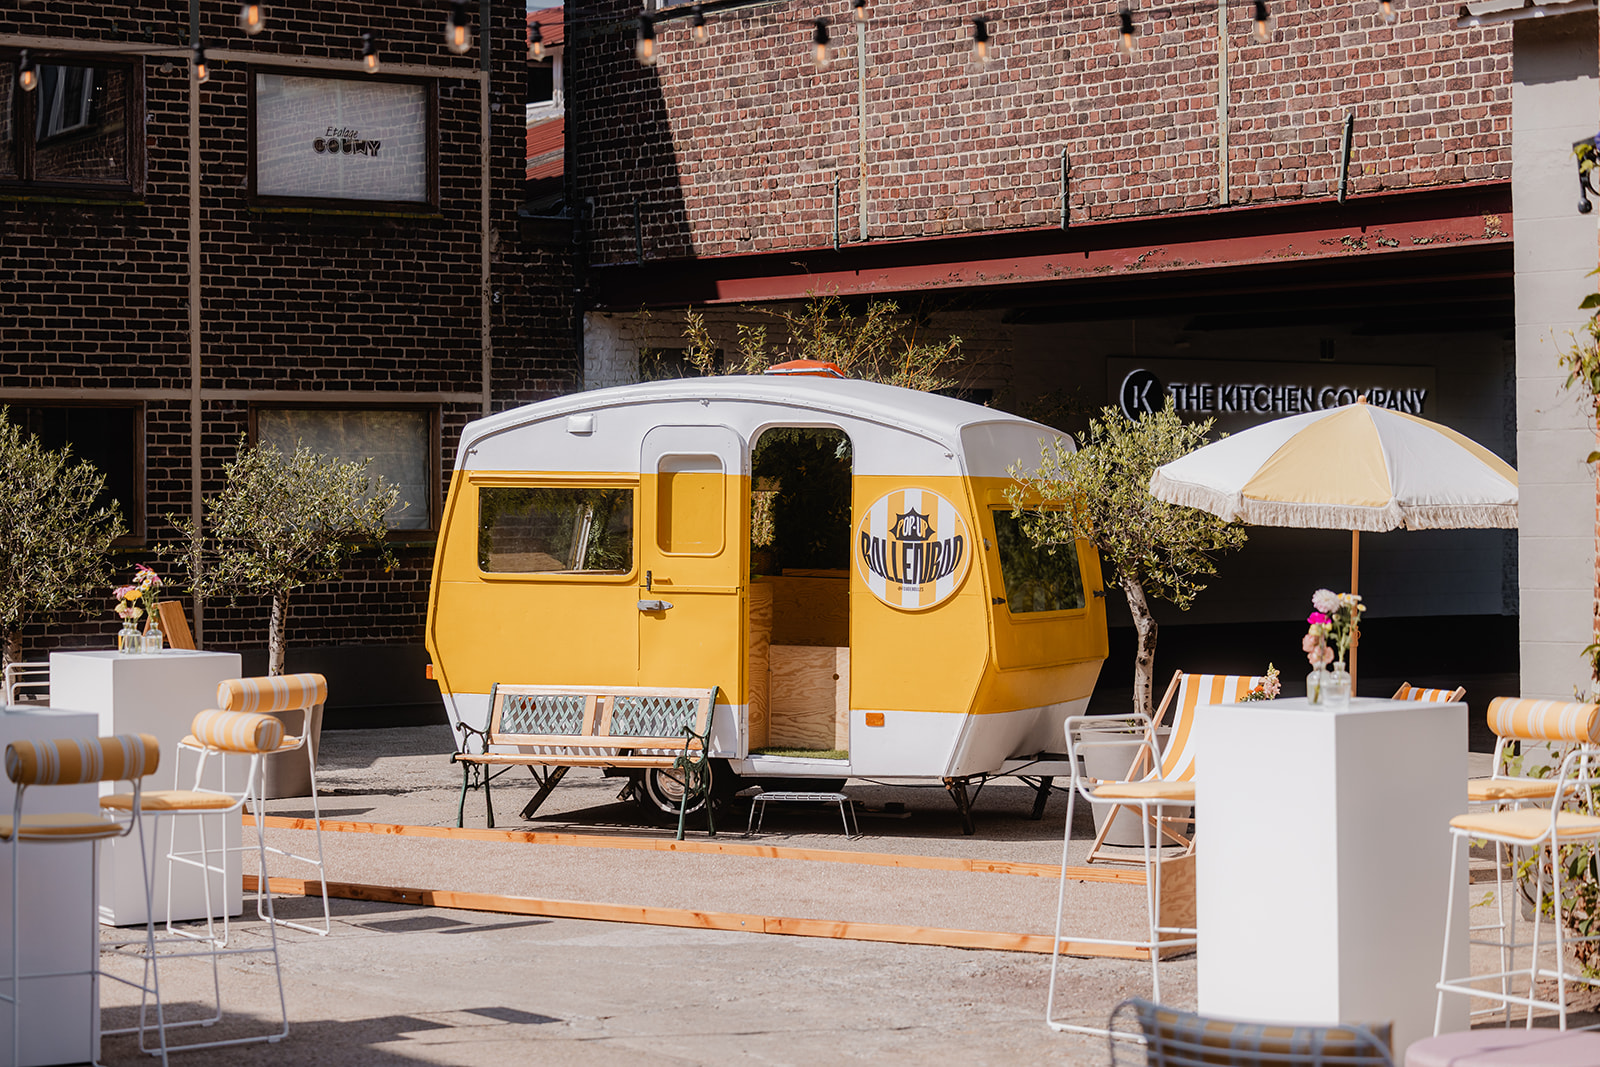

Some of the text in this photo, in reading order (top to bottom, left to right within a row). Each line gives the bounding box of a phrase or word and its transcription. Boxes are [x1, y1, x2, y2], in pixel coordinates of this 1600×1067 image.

[326, 126, 358, 139] Etalage
[1168, 383, 1214, 412] THE
[1218, 384, 1315, 413] KITCHEN
[896, 515, 928, 538] POP-UP
[861, 531, 964, 585] BALLENBAD
